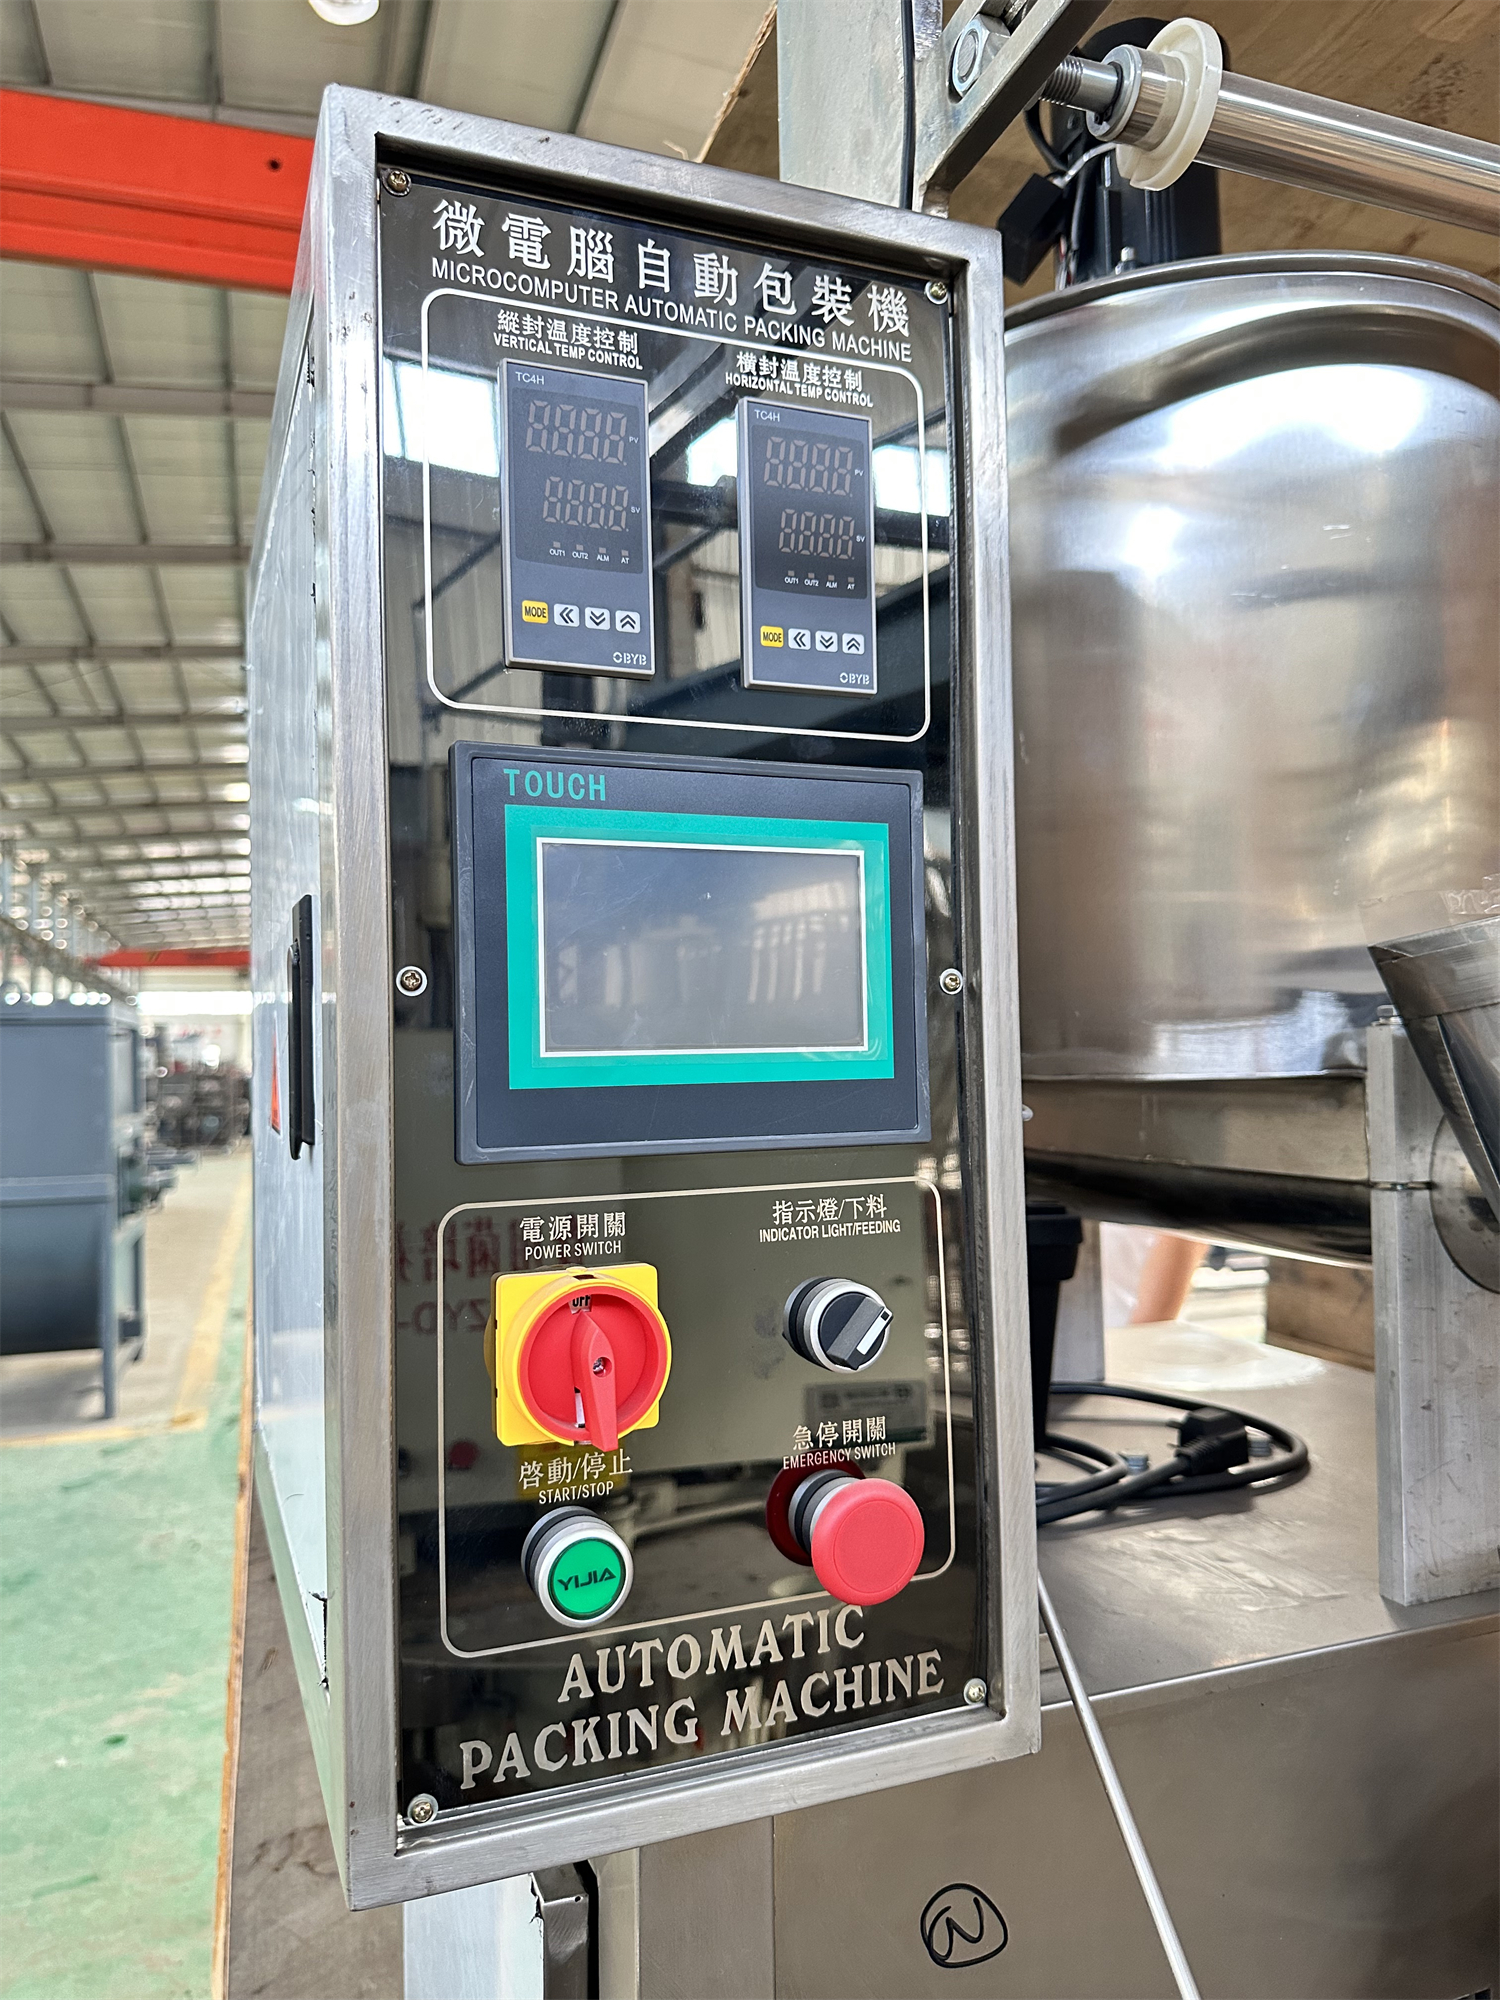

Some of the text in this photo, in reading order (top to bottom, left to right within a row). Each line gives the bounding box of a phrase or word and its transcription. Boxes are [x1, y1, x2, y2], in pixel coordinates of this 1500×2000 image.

[432, 199, 910, 337] 微電腦自動包裝機
[432, 257, 912, 363] MICROCOMPUTER AUTOMATIC PACKING MACHINE
[493, 332, 643, 370] VERTICAL TEMP CONTROL
[515, 371, 545, 385] TC4H
[725, 372, 874, 408] HORIZONTAL TEMP CONTROL
[754, 409, 781, 422] TC4H
[628, 435, 639, 444] PV
[854, 469, 864, 477] PV
[630, 506, 641, 514] SV
[856, 535, 866, 543] SV
[549, 548, 566, 557] OUT1
[572, 551, 589, 560] OUT2
[596, 554, 610, 562] ALM
[784, 576, 799, 585] OUT1
[804, 579, 819, 587] OUT2
[825, 581, 838, 589] ALM
[524, 606, 547, 619] MODE
[763, 631, 782, 643] MODE
[503, 768, 606, 801] TOUCH
[519, 1211, 626, 1243] 電源開關
[759, 1219, 901, 1243] INDICATOR LIGHT/FEEDING
[525, 1240, 622, 1261] POWER SWITCH
[792, 1415, 887, 1451] 急停開關
[783, 1442, 896, 1470] EMERGENCY SWITCH
[538, 1480, 614, 1505] START/STOP
[557, 1567, 617, 1591] YIJIA
[557, 1605, 865, 1703] AUTOMATIC
[459, 1649, 945, 1790] PACKING MACHINE
